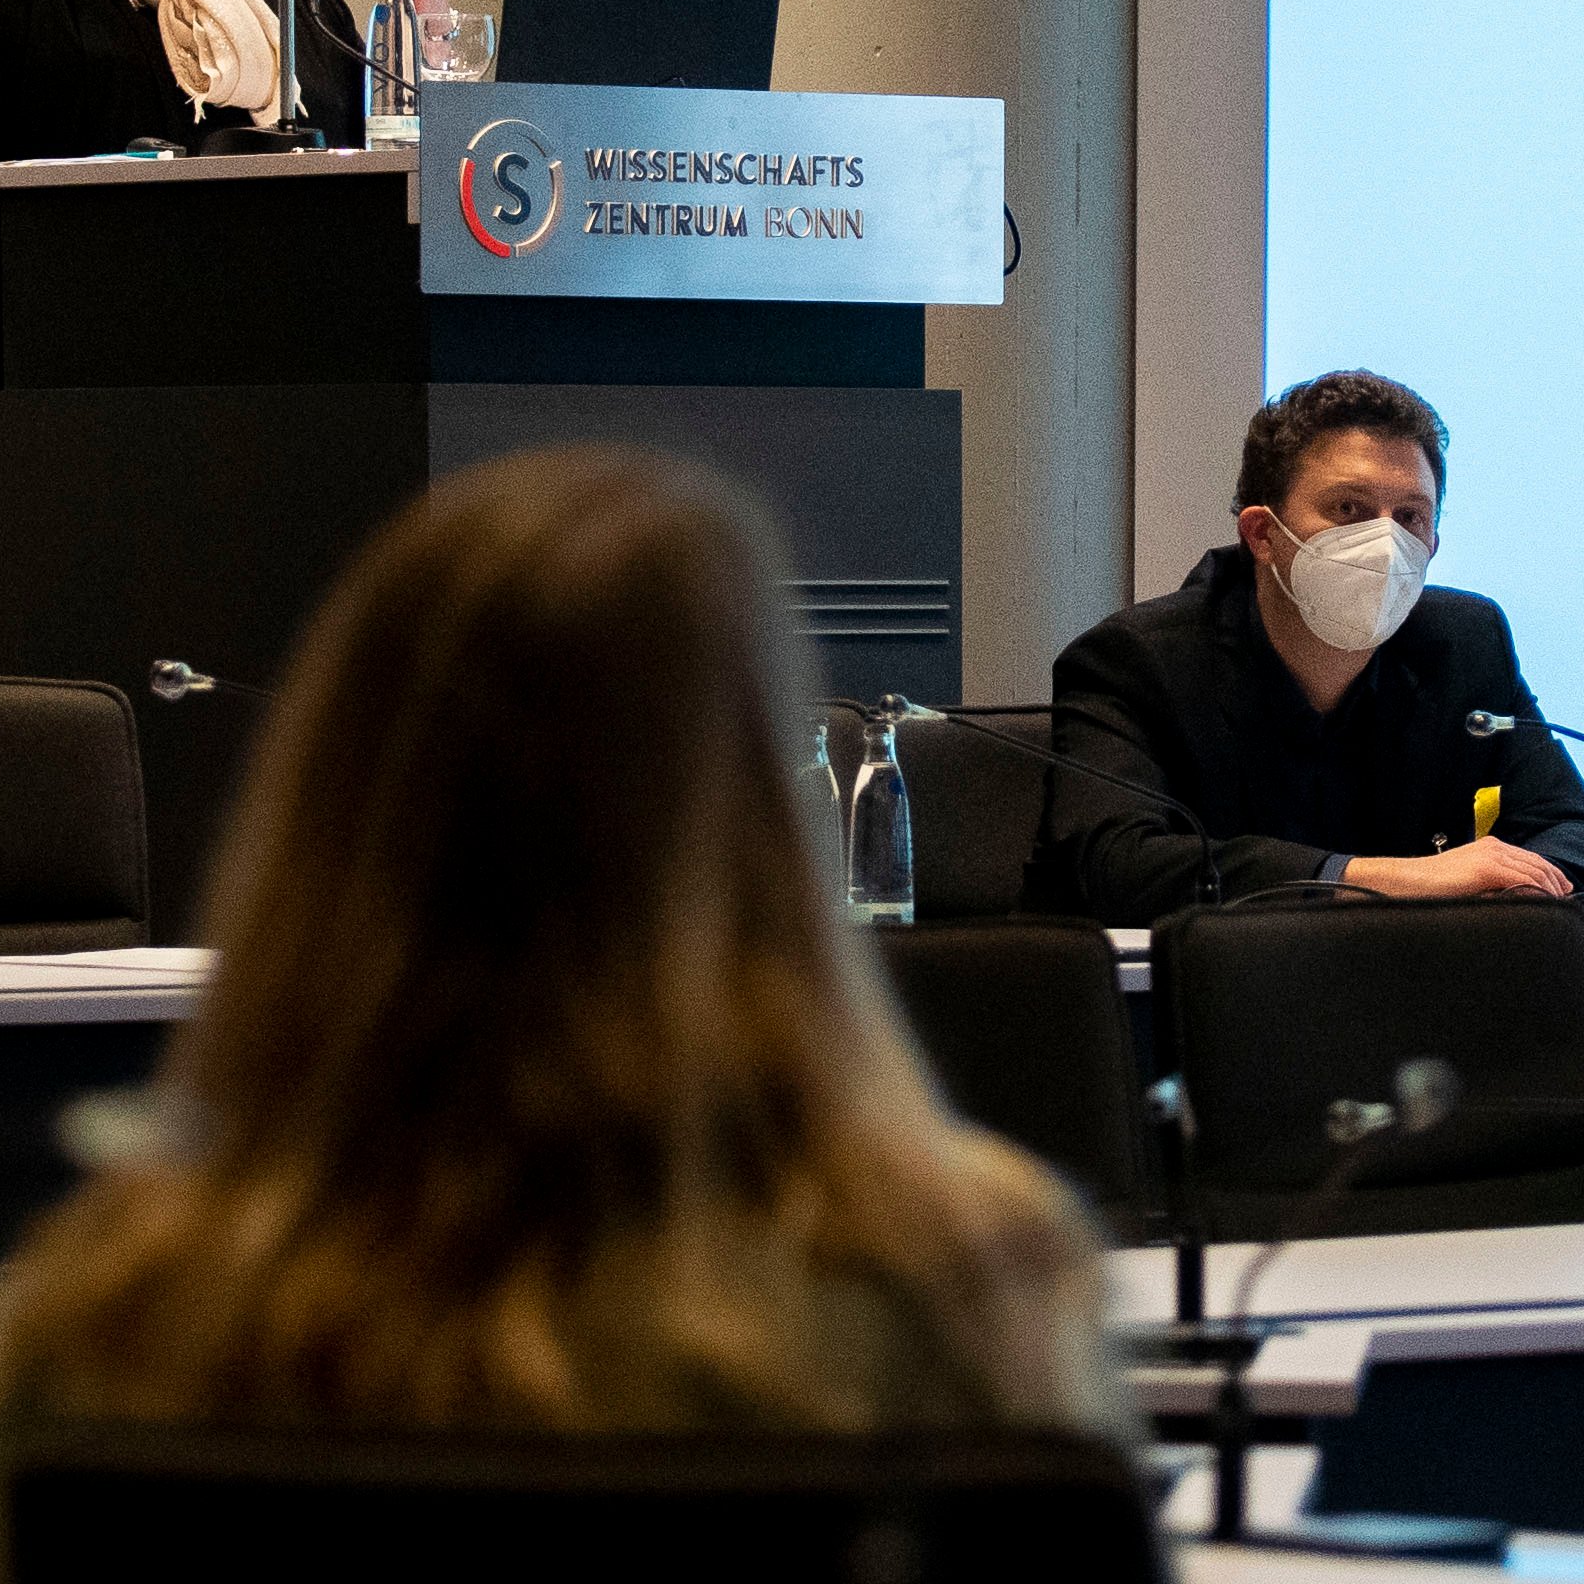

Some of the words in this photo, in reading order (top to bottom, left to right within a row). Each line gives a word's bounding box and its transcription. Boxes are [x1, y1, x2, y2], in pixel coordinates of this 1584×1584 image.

[585, 147, 865, 188] WISSENSCHAFTS
[583, 200, 749, 237] ZENTRUM
[764, 205, 865, 239] BONN
